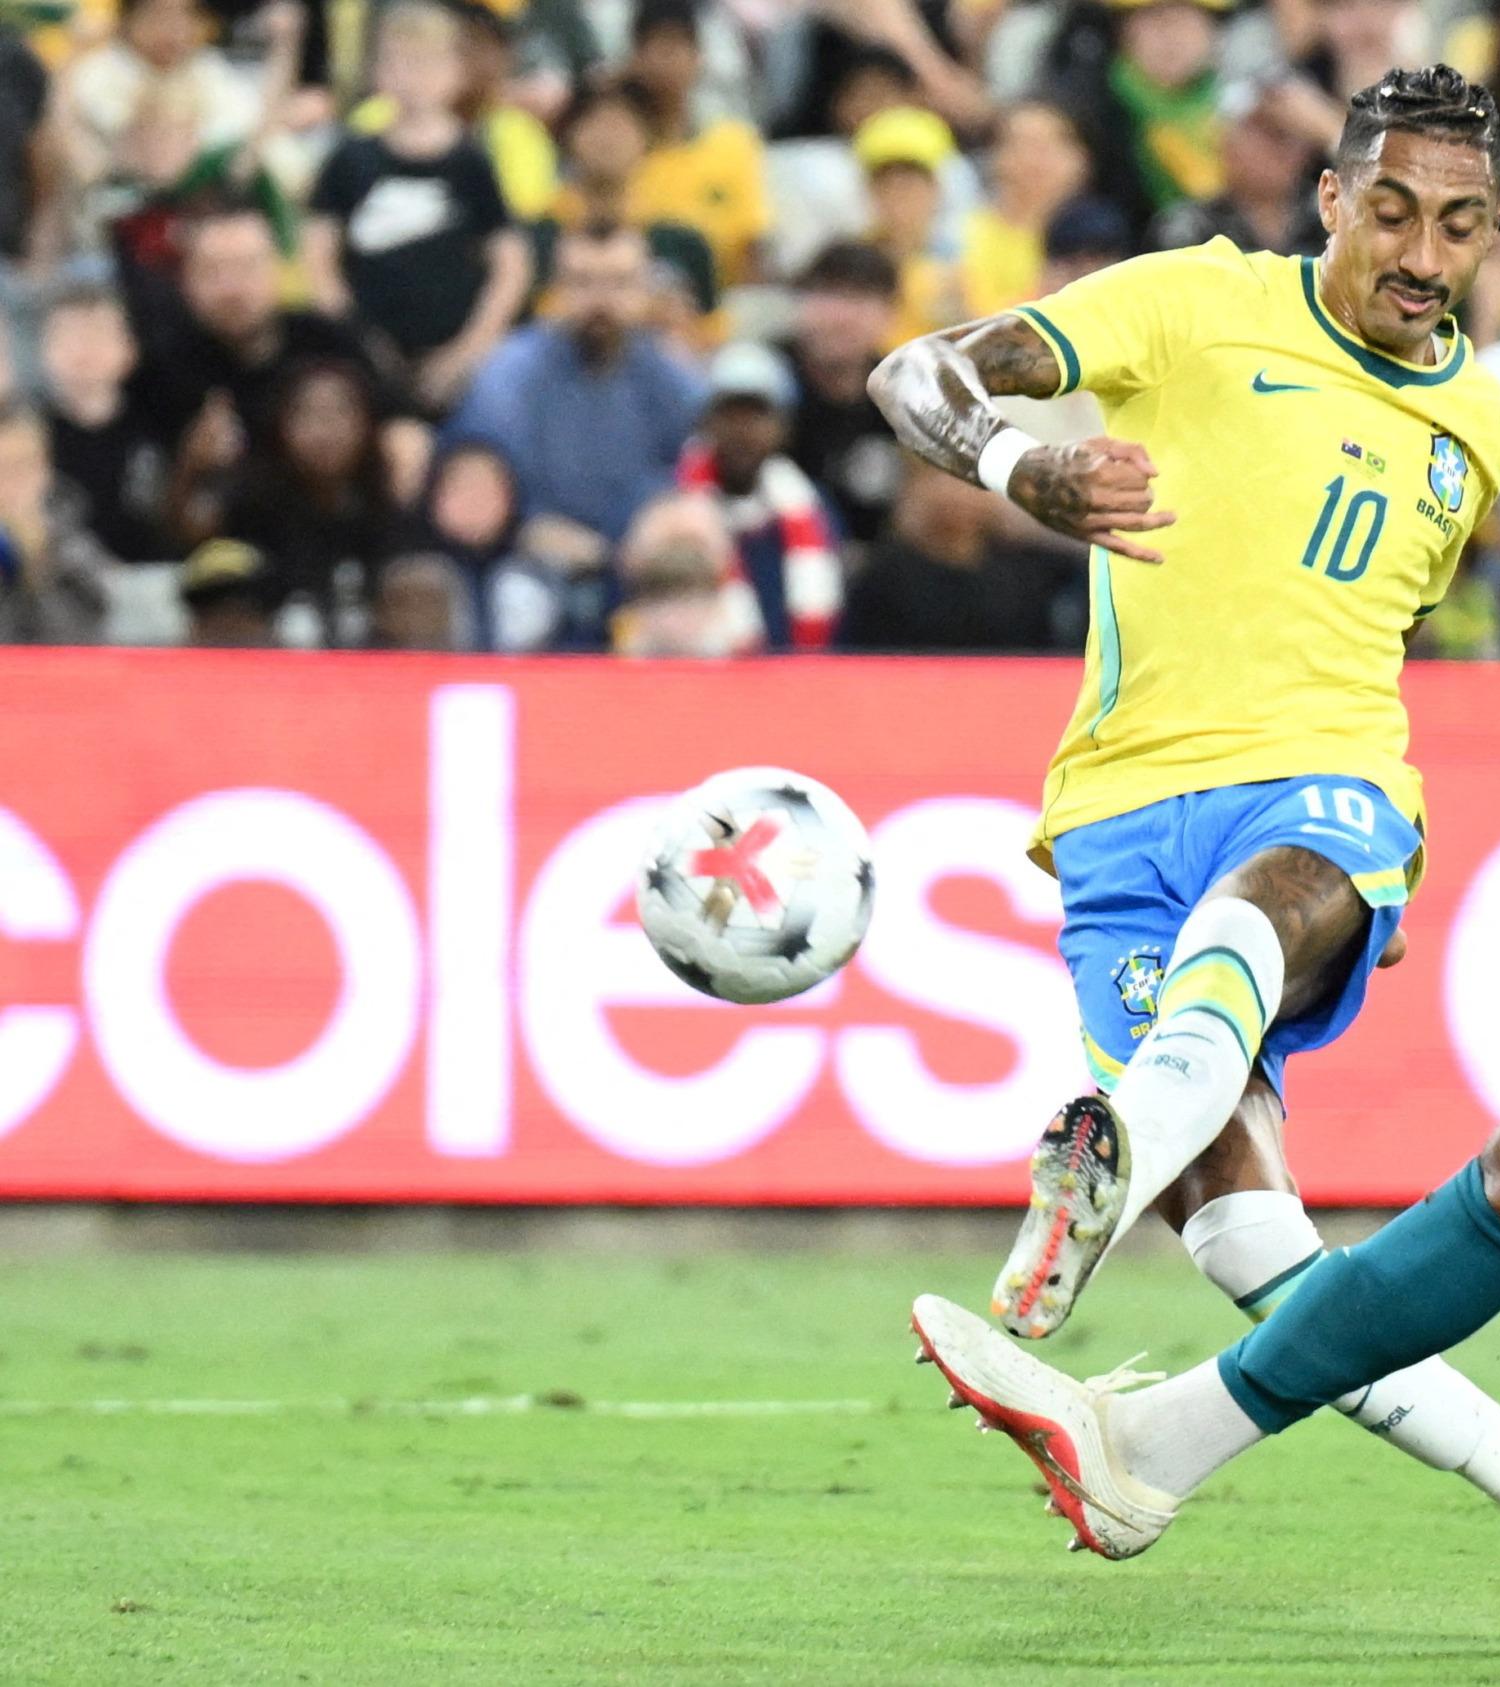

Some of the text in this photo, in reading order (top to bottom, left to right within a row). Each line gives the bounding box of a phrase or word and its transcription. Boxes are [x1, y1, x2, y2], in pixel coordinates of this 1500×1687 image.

[1301, 475, 1388, 582] 10
[1298, 784, 1375, 836] 10
[0, 683, 1097, 1167] oles
